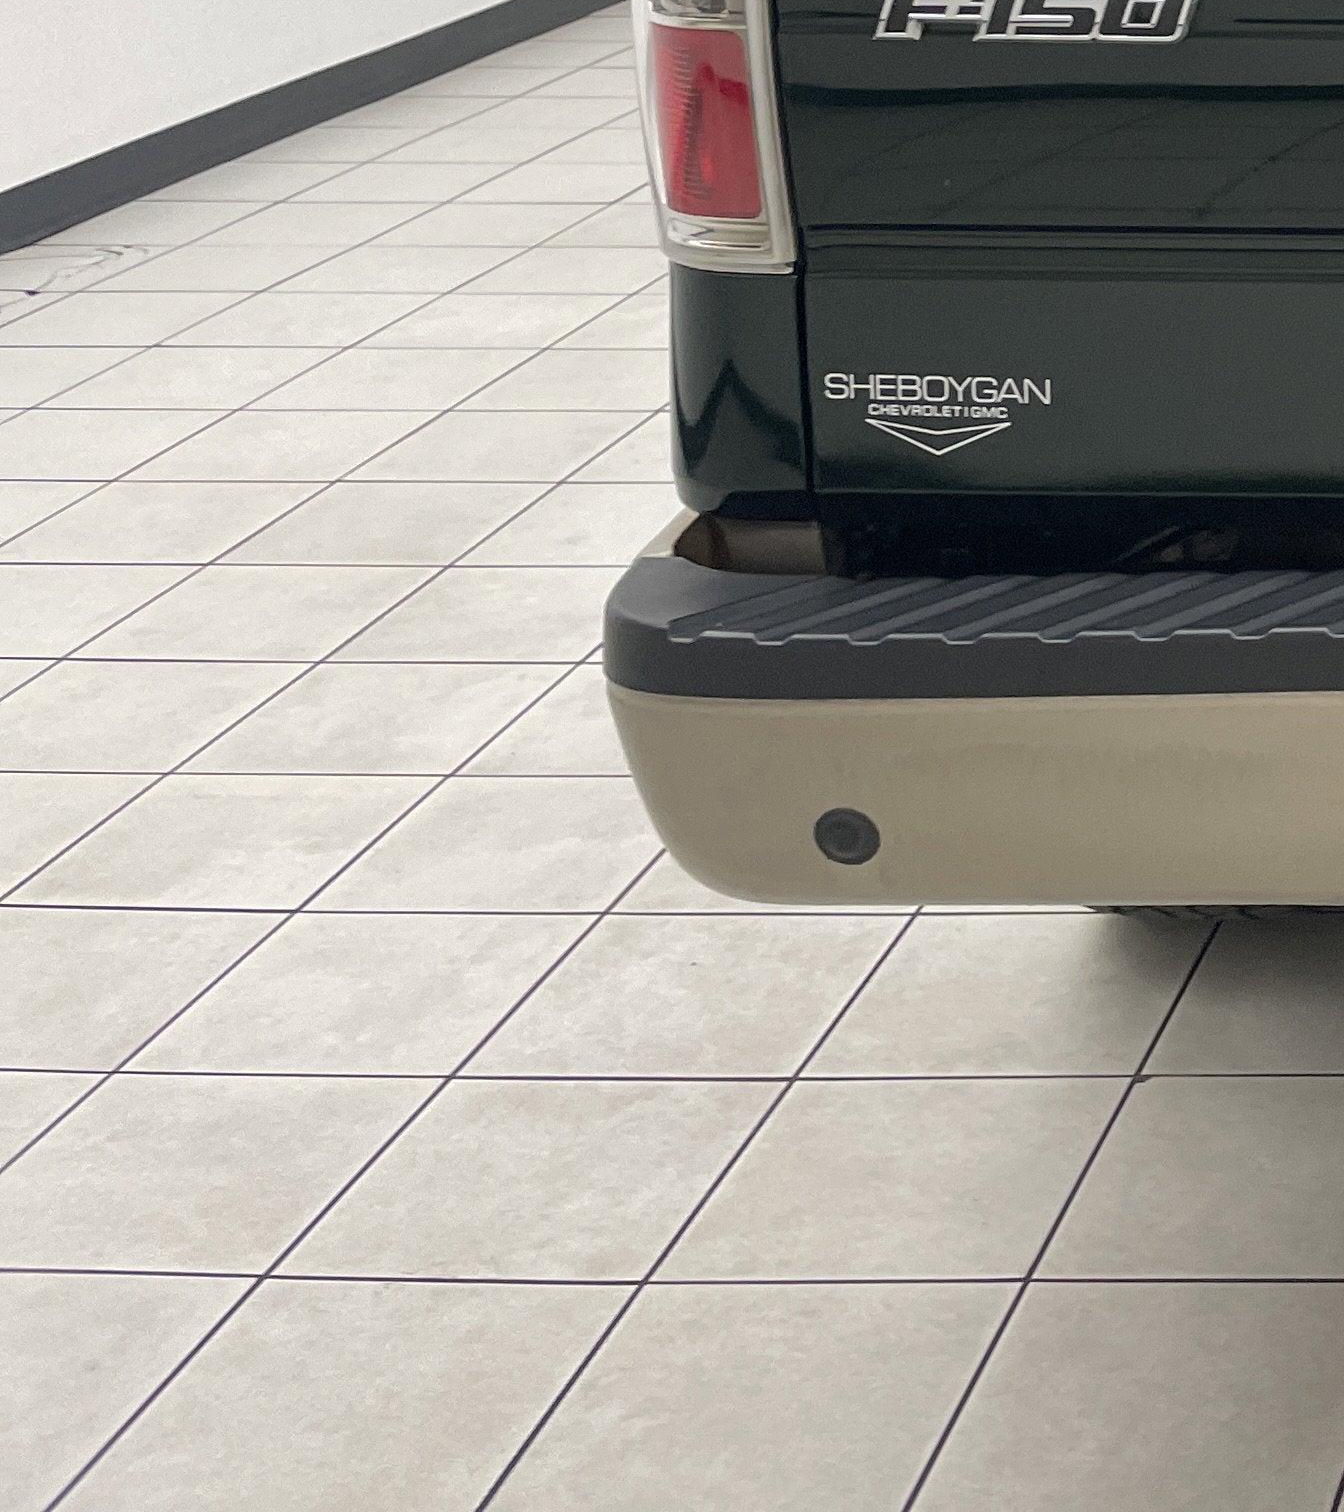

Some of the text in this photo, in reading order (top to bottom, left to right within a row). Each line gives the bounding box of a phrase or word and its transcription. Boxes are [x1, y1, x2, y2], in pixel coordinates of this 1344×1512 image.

[823, 372, 1052, 405] SHEBOYGAN
[867, 403, 1009, 418] CHEVROLET GMC
